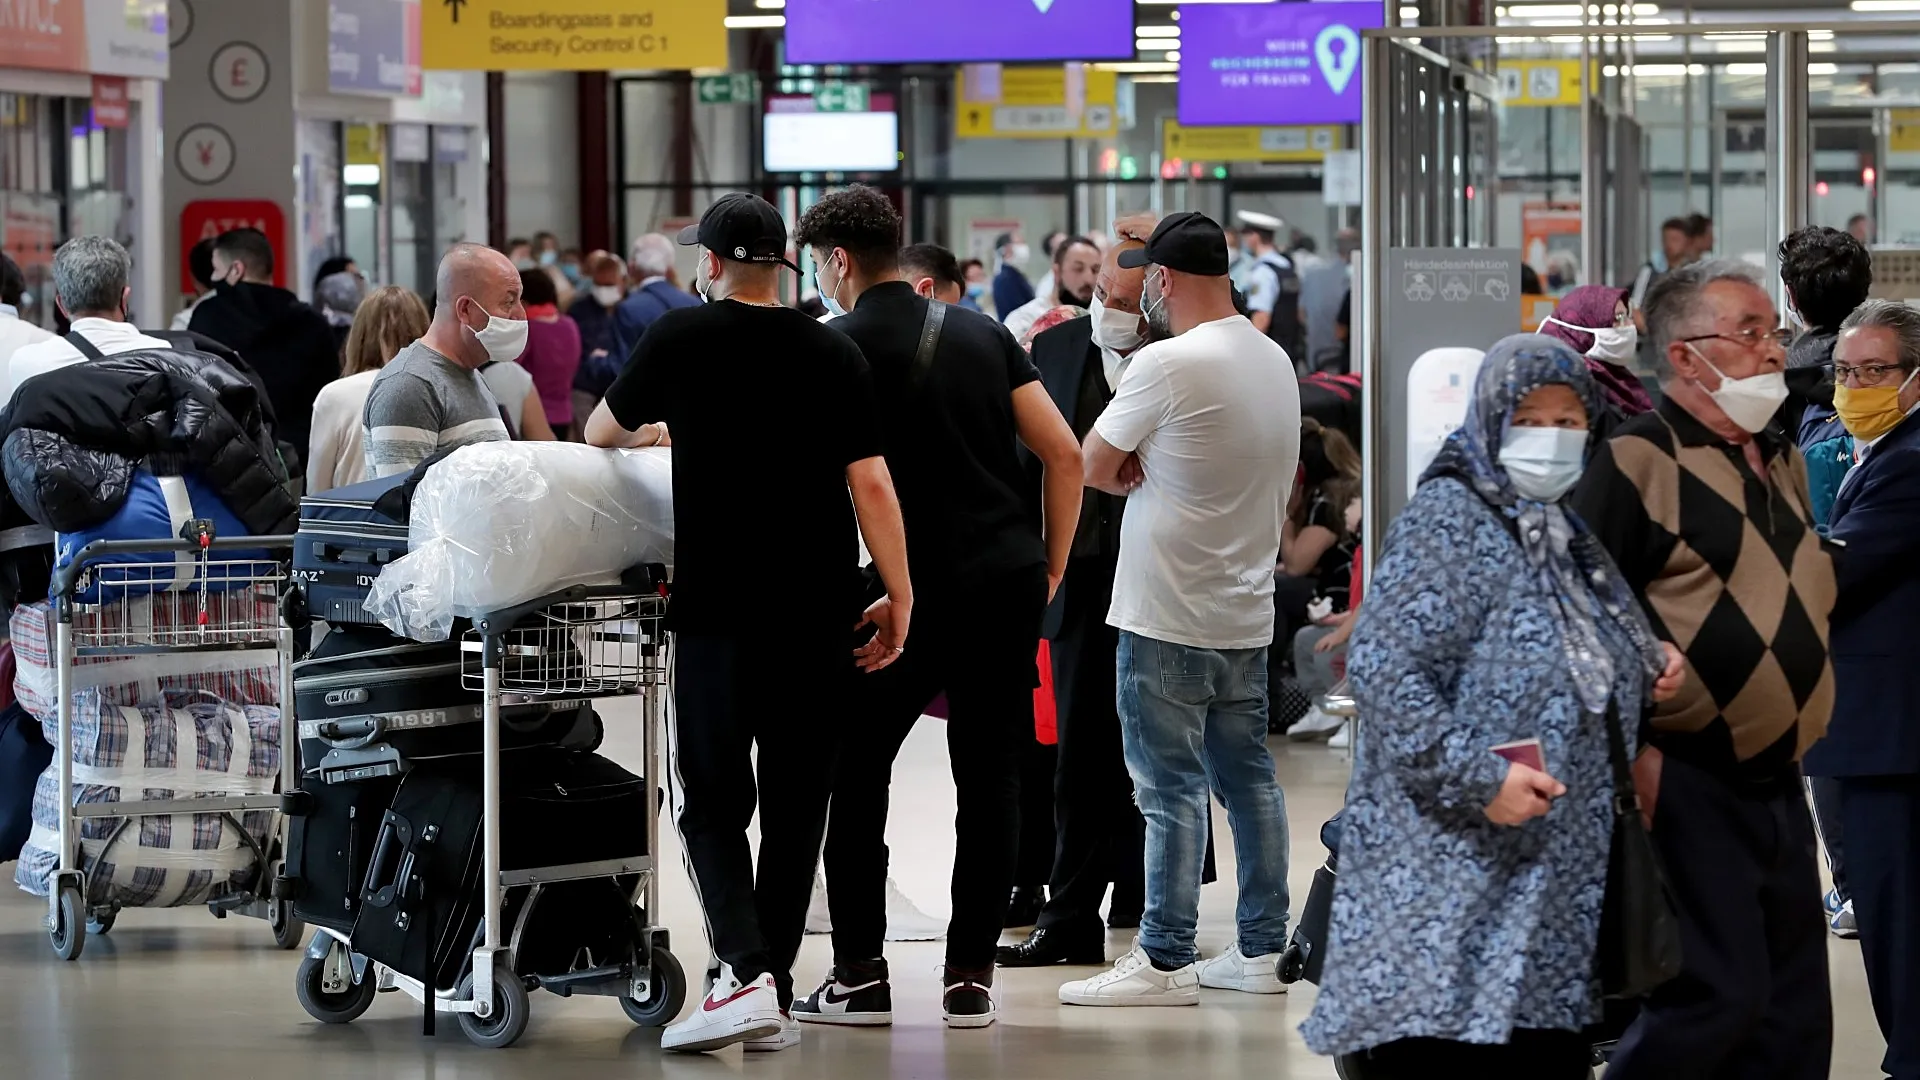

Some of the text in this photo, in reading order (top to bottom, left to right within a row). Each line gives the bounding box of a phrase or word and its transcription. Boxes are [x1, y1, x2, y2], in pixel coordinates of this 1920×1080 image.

[489, 10, 654, 32] Boardingpass and
[489, 34, 668, 57] Security Control C 1
[1403, 259, 1509, 271] Händedesinfektion
